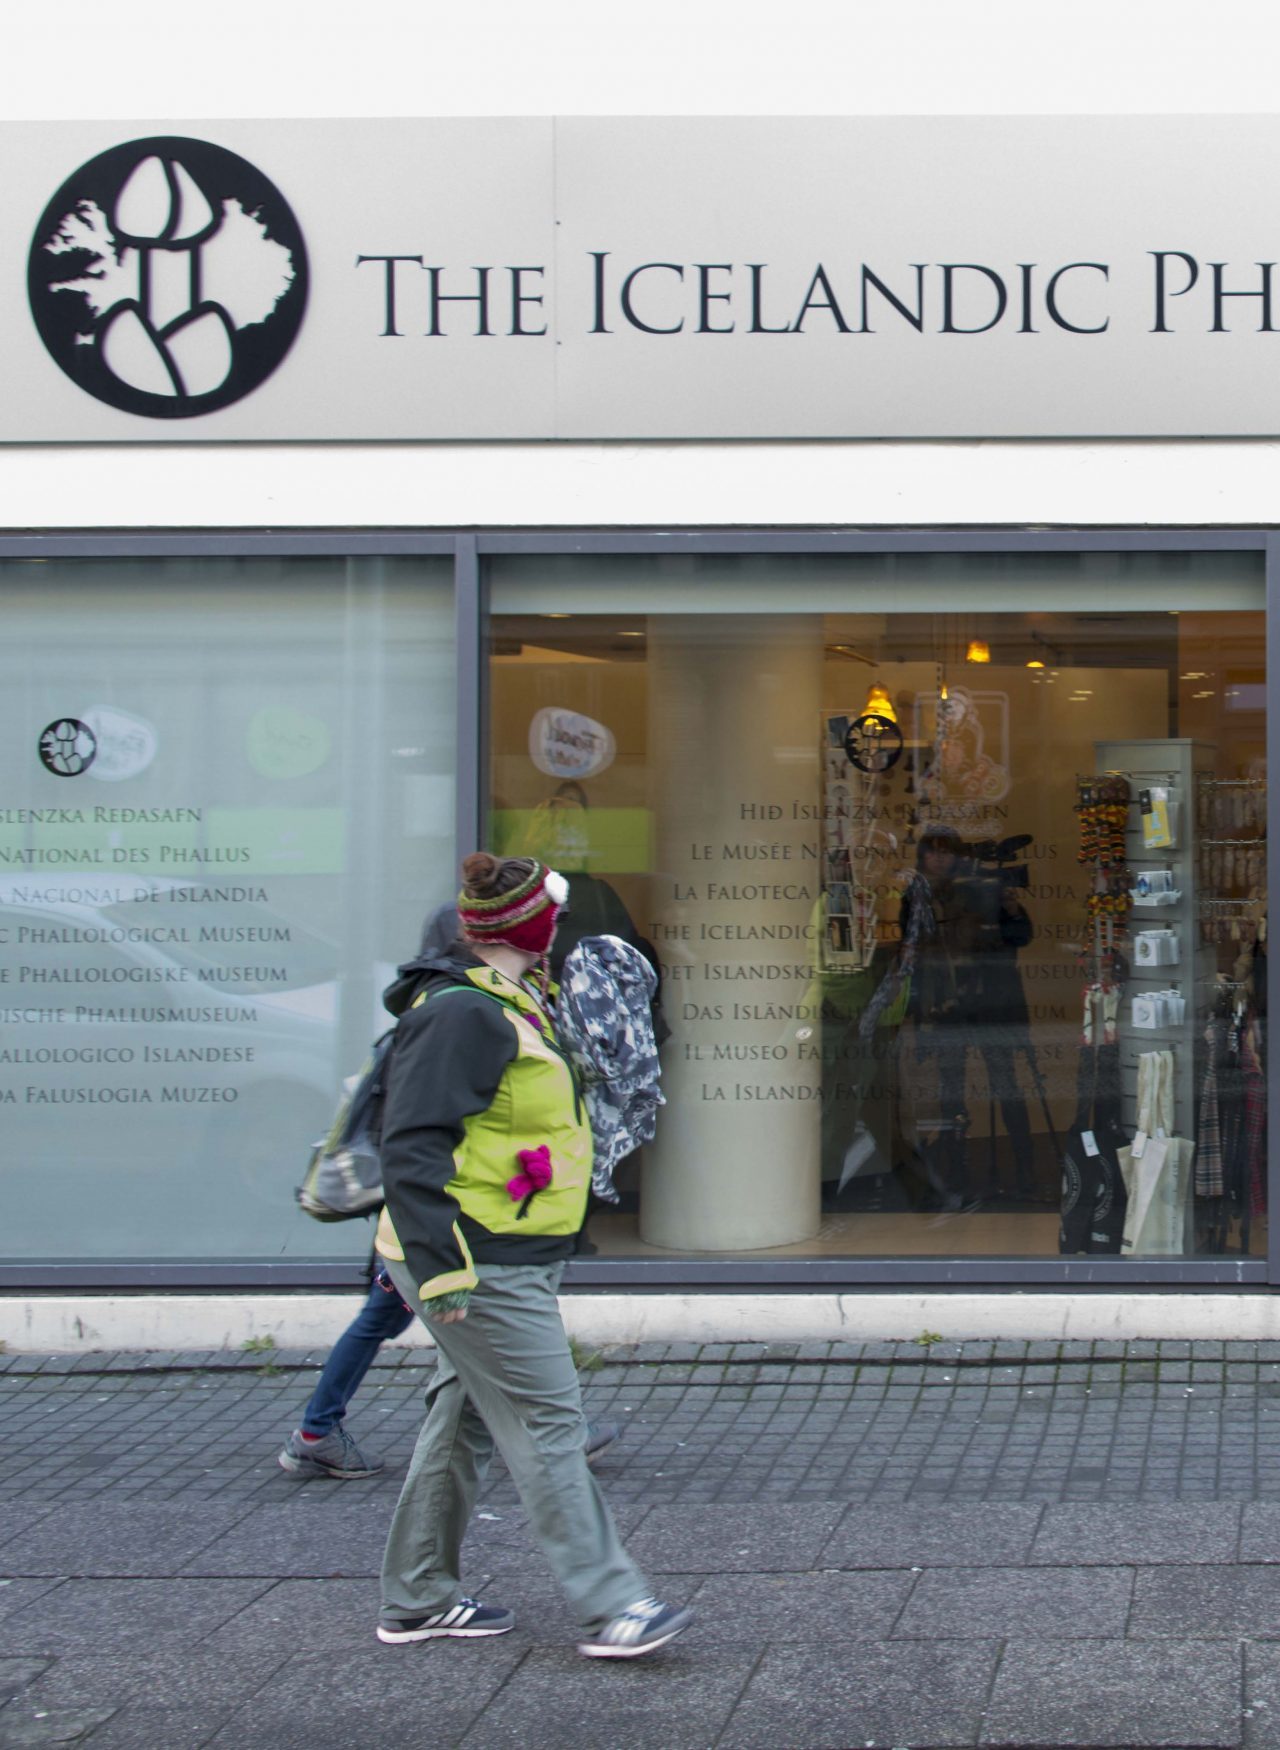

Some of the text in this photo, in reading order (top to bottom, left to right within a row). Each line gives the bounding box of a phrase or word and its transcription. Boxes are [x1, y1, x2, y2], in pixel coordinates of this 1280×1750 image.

[355, 252, 549, 338] THE
[586, 250, 1112, 335] ICELANDIC
[112, 847, 150, 863] DES
[159, 845, 251, 863] PHALLUS
[691, 843, 713, 860] LE
[12, 886, 122, 904] NACIONAL
[134, 887, 160, 903] DE
[674, 883, 698, 901] LA
[708, 882, 811, 901] FALOTECA
[17, 926, 190, 944] PHALLOLOGICAL
[199, 925, 292, 943] MUSEUM
[648, 922, 691, 941] THE
[700, 922, 816, 941] ICELANDIC
[19, 965, 190, 983] PHALLOLOGISKE
[75, 1005, 258, 1023] PHALLUSMUSEUM
[683, 1002, 723, 1021] DAS
[144, 1045, 255, 1063] ISLANDESE
[713, 1042, 788, 1061] MUSEO
[26, 1086, 153, 1104] FALUSLOGIA
[160, 1086, 239, 1104] MUZEO
[702, 1083, 725, 1101] LA
